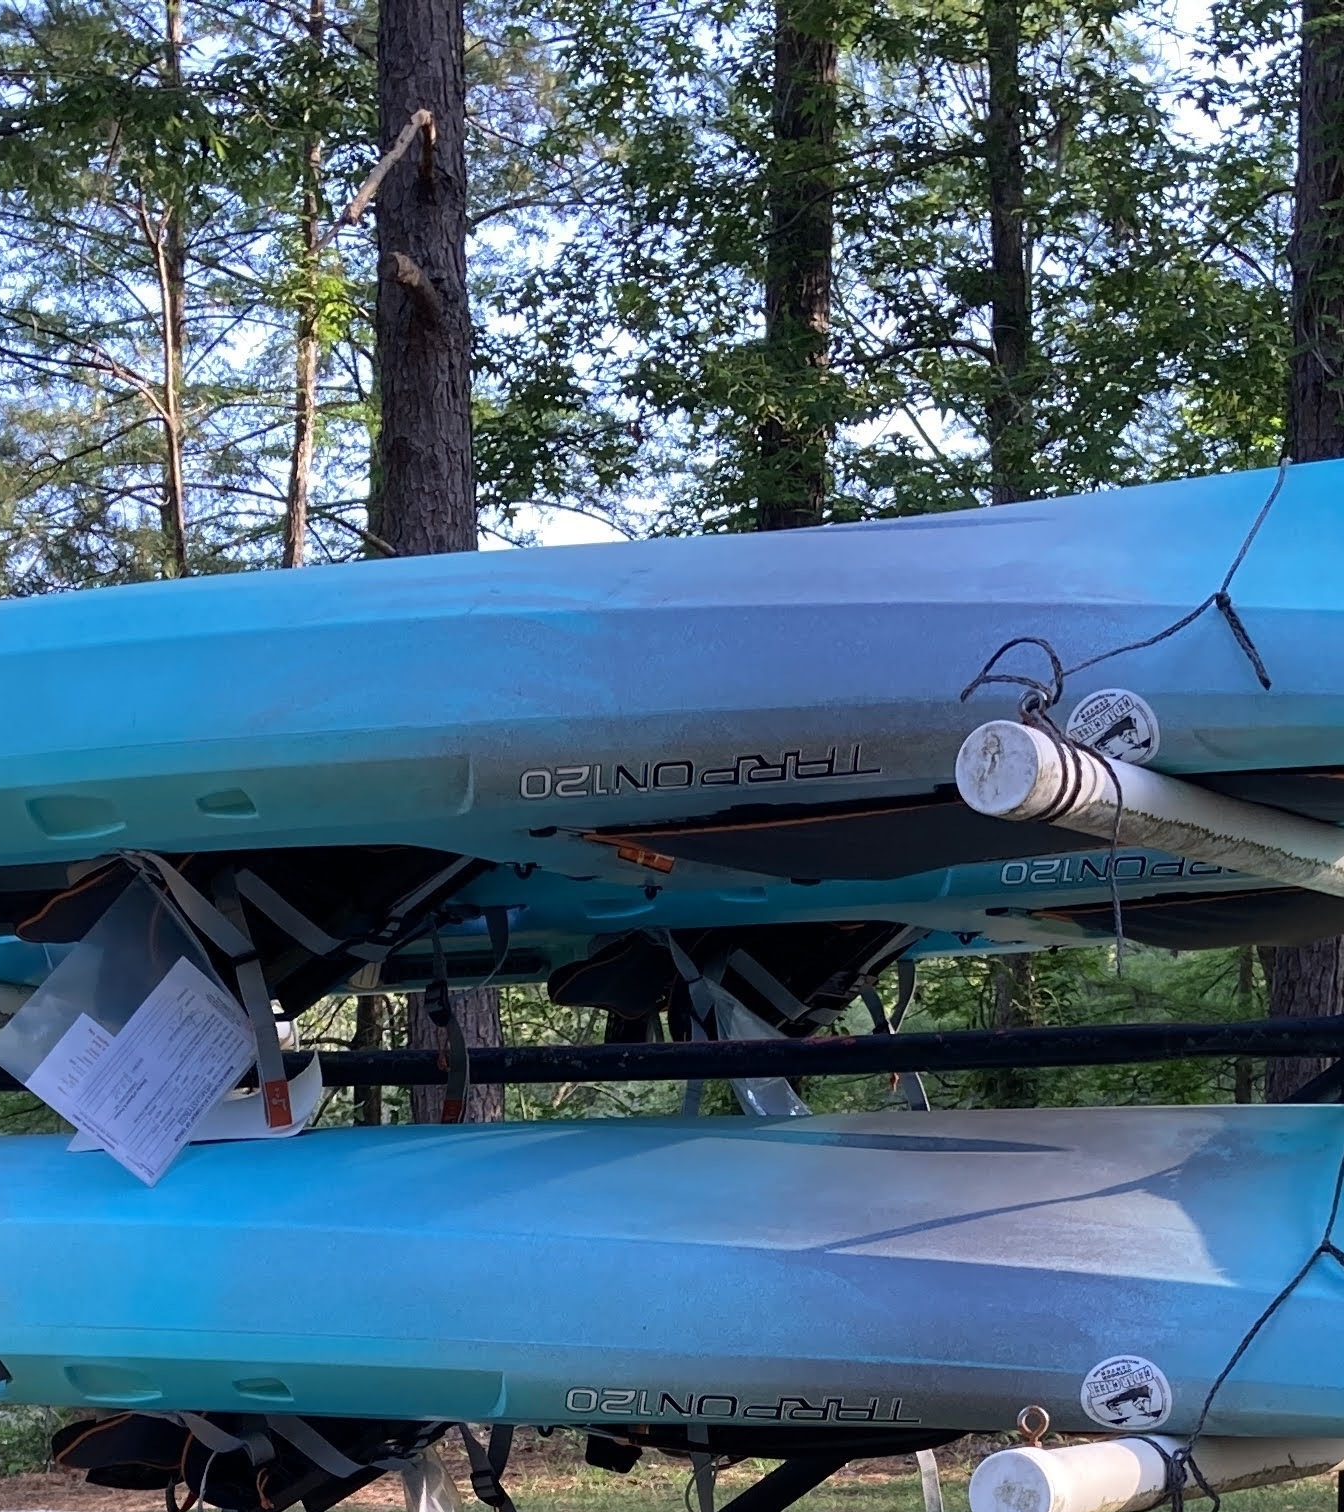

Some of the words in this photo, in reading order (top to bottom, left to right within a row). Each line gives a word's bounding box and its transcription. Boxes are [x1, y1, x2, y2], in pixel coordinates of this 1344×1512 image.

[1100, 694, 1135, 726] CEDAR
[1069, 717, 1105, 743] CREEK
[1086, 1379, 1121, 1398] CREEK
[1119, 1365, 1154, 1389] CEDAR
